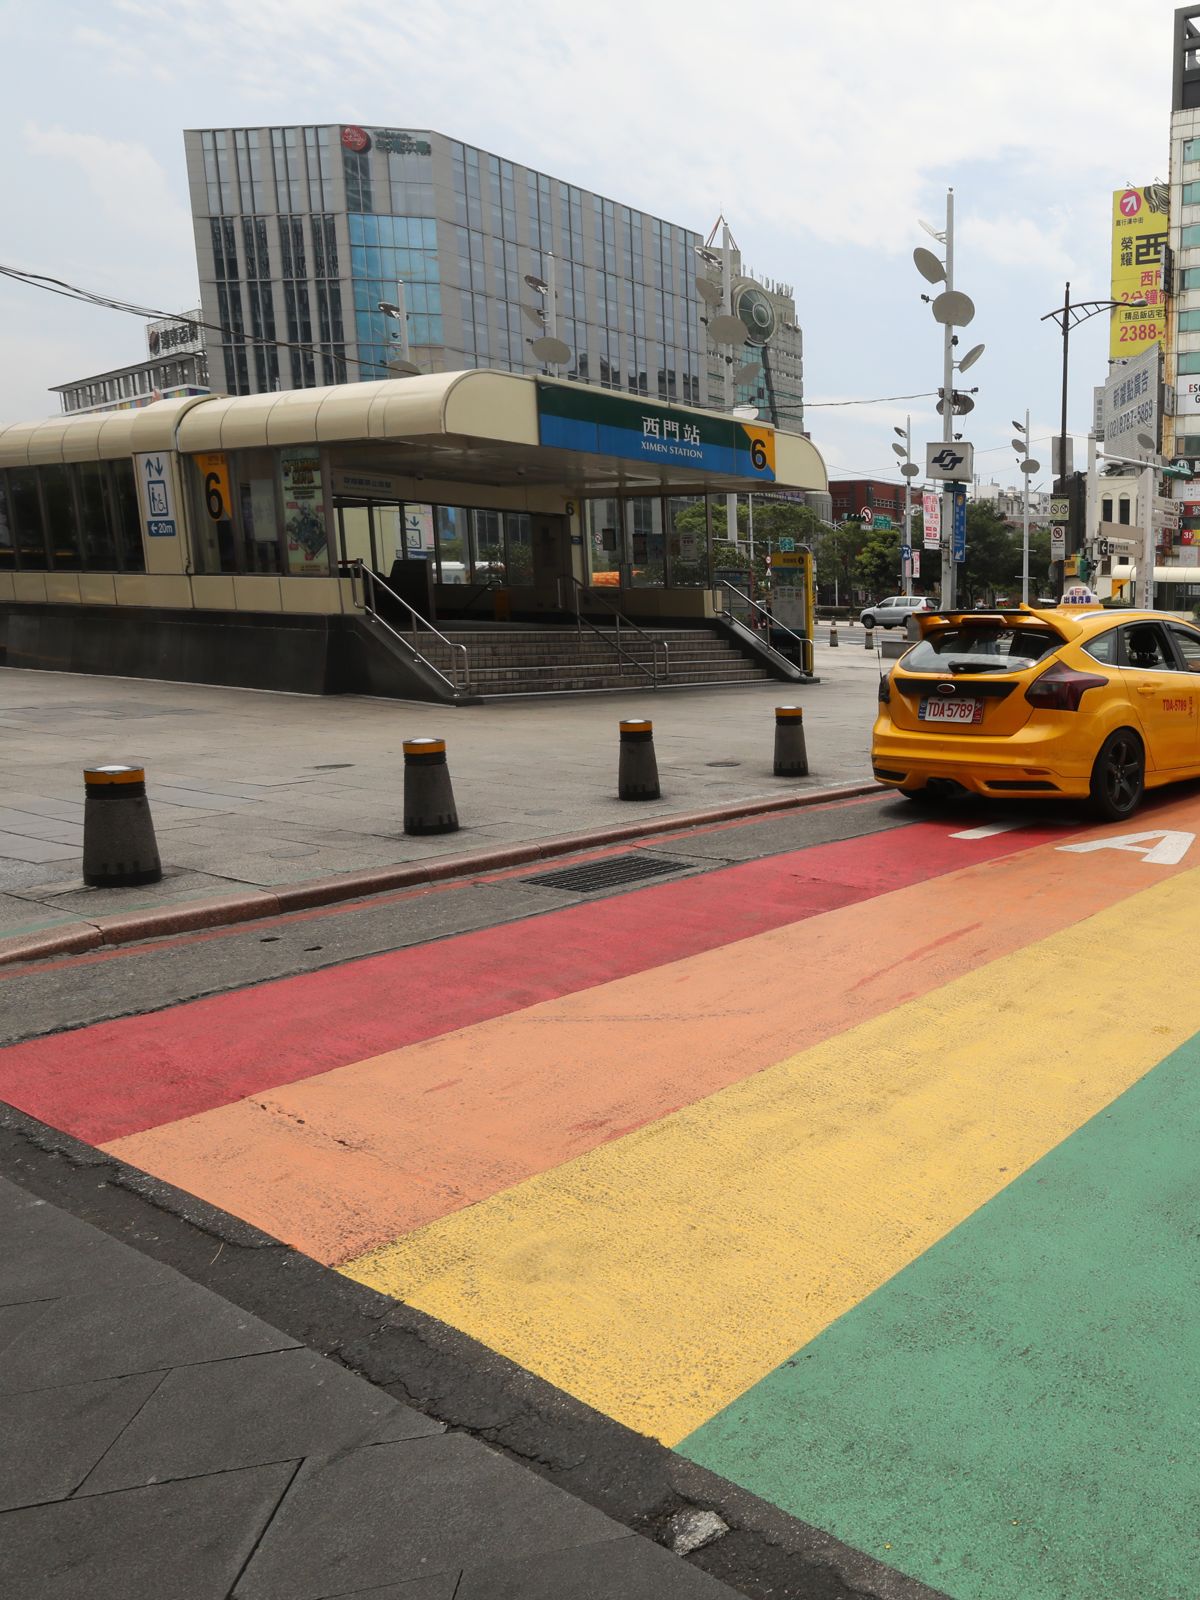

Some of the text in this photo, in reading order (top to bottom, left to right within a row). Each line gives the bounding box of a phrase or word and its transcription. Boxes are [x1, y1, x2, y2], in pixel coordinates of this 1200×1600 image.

[1120, 236, 1133, 267] 榮耀
[1124, 310, 1166, 321] 精品飯店宅
[641, 416, 701, 446] 西門站
[641, 440, 703, 459] XIMEN STATION
[750, 438, 768, 471] 6
[204, 471, 224, 520] 6
[564, 501, 575, 516] 6
[158, 523, 173, 534] 20m
[928, 702, 973, 719] TDA-5789
